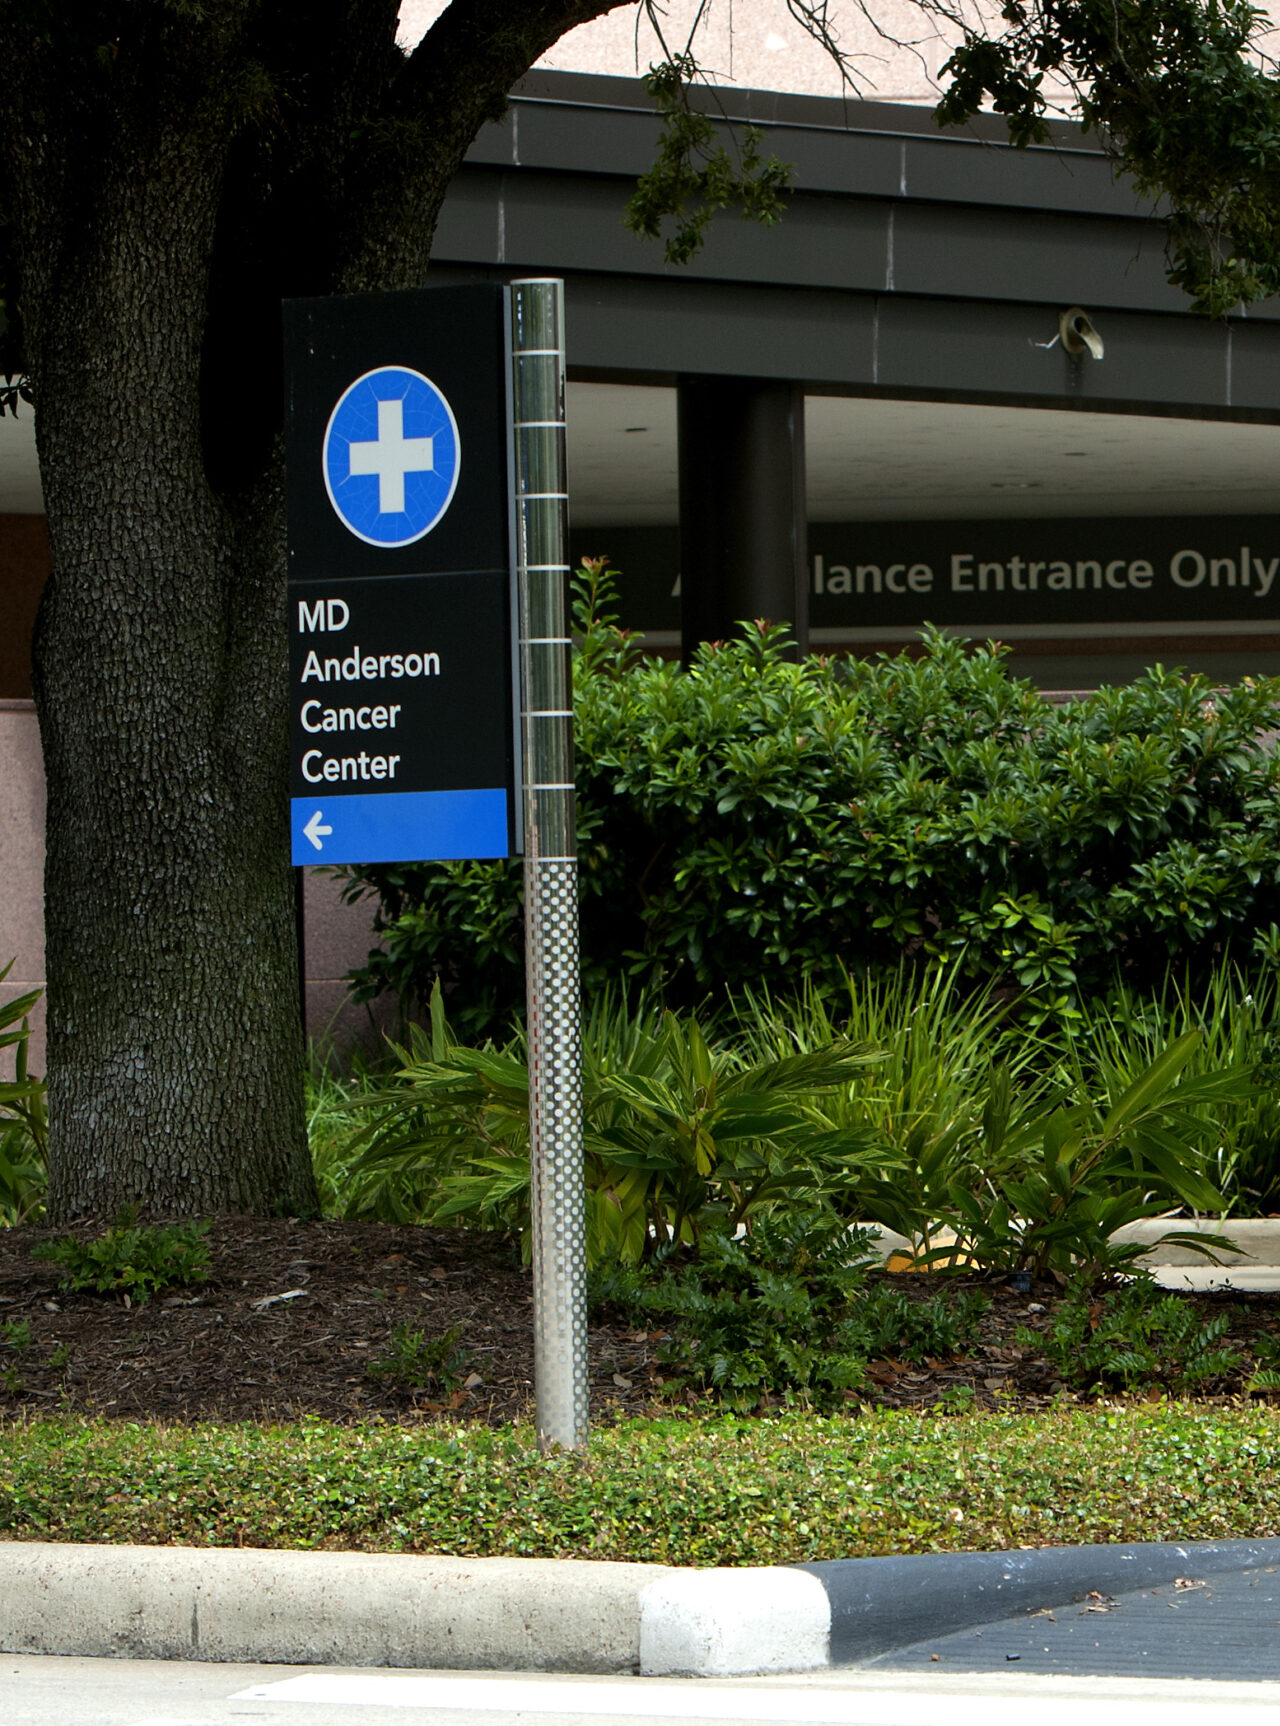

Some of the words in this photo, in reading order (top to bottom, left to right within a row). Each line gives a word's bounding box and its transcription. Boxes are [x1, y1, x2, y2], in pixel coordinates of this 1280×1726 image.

[951, 554, 1153, 592] Entrance
[1170, 547, 1280, 597] Only
[298, 599, 350, 633] MD
[301, 646, 440, 683] Anderson
[300, 700, 401, 733] Cancer
[301, 750, 400, 783] Center
